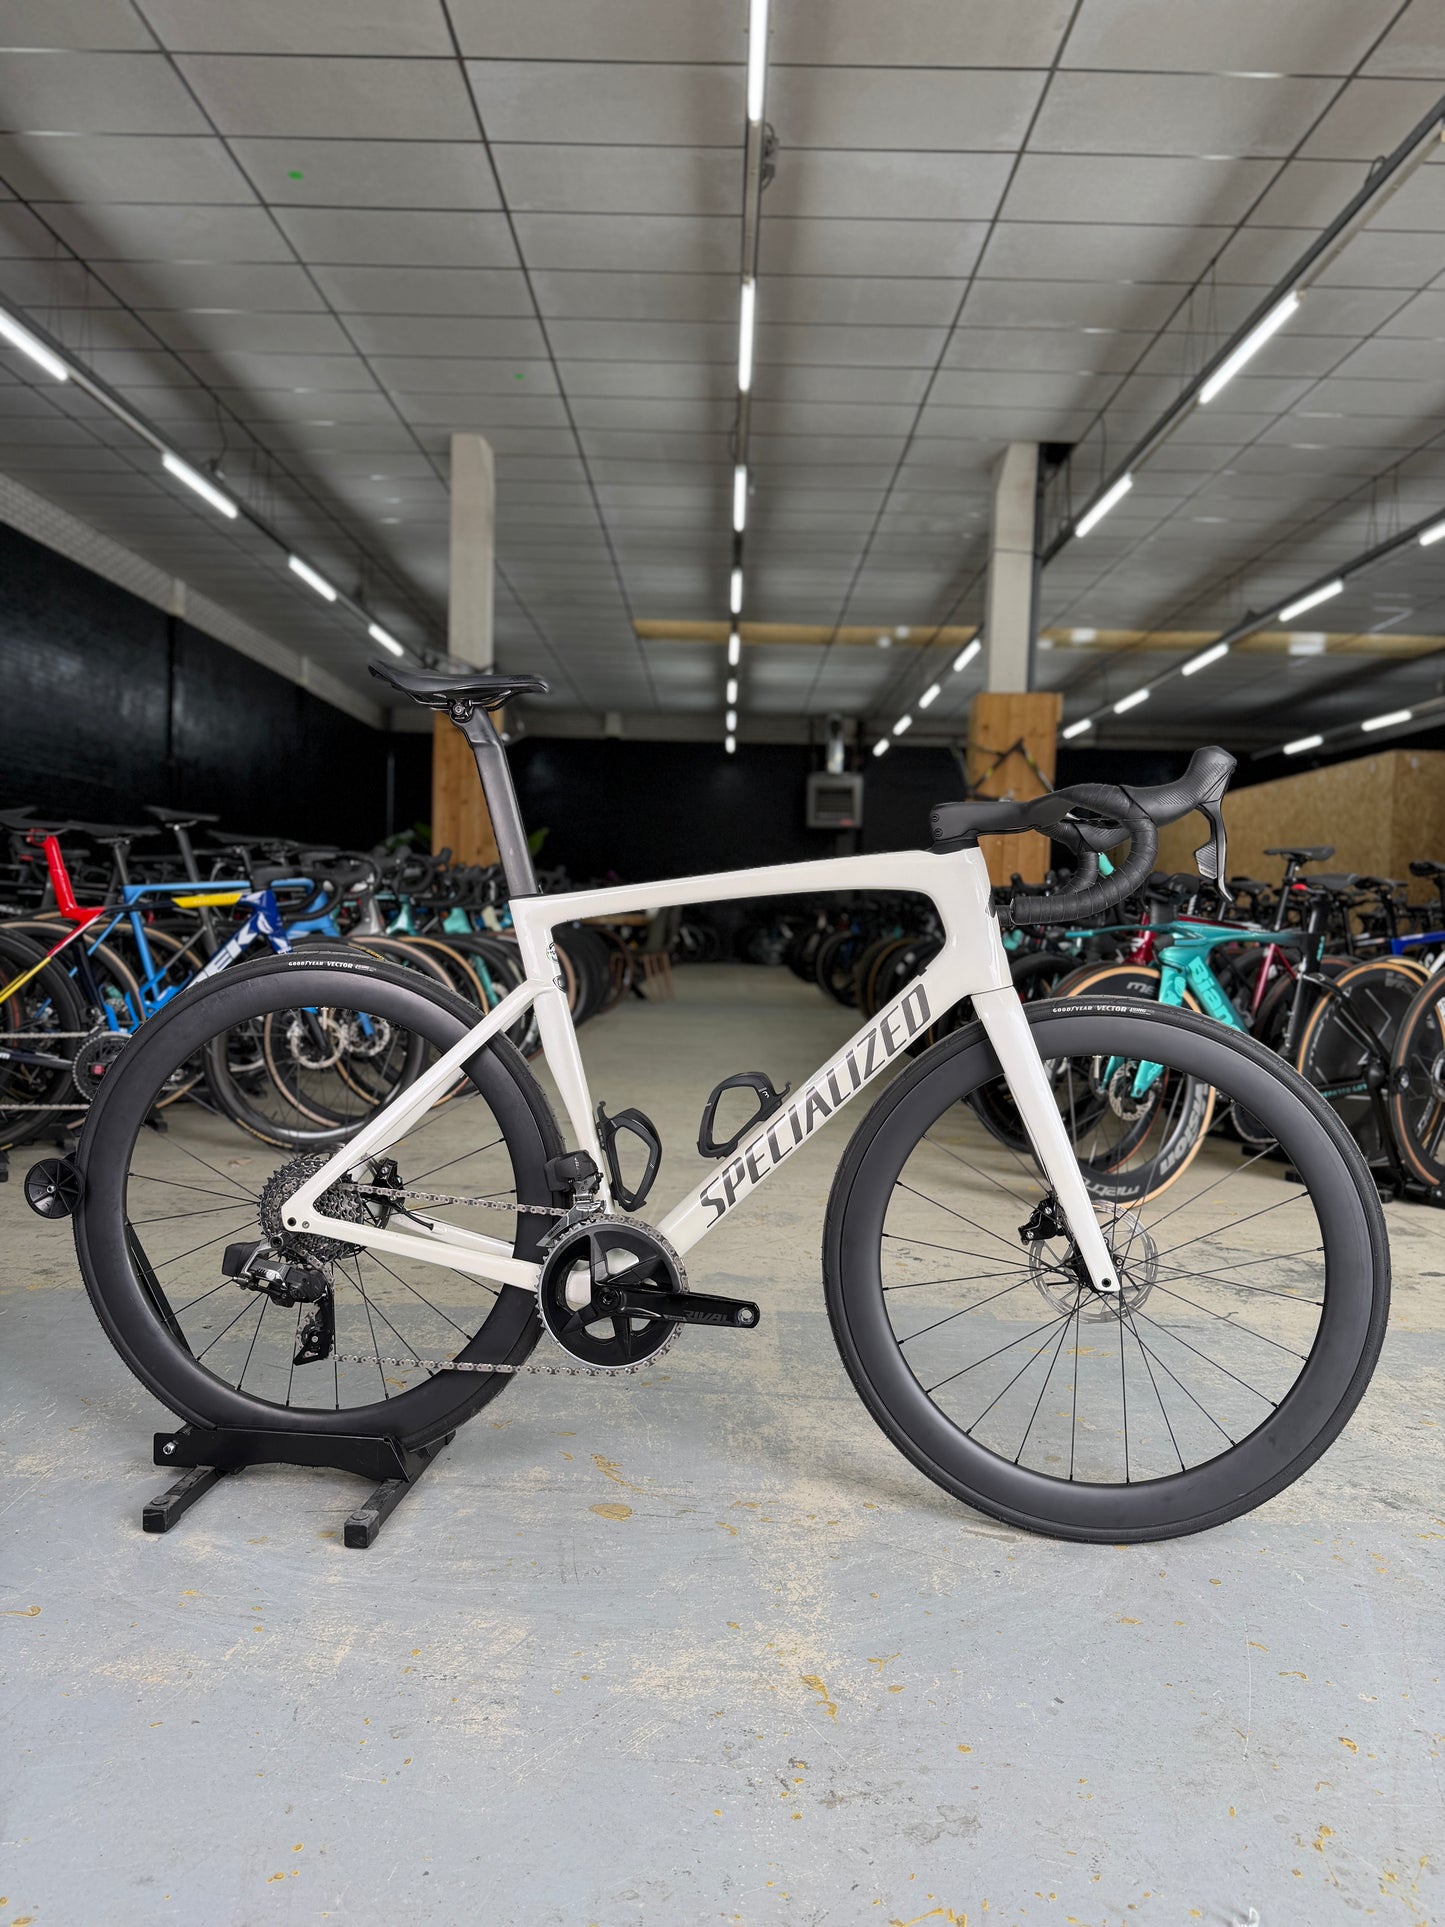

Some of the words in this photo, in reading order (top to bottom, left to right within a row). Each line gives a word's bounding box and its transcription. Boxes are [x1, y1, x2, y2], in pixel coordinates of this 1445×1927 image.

[186, 920, 258, 989] EK
[327, 961, 354, 969] VECTOR
[1052, 1005, 1093, 1013] GOODYEAR
[1096, 1005, 1127, 1013] VECTOR
[1188, 956, 1241, 1031] Bian
[700, 984, 931, 1228] SPECIALIZED
